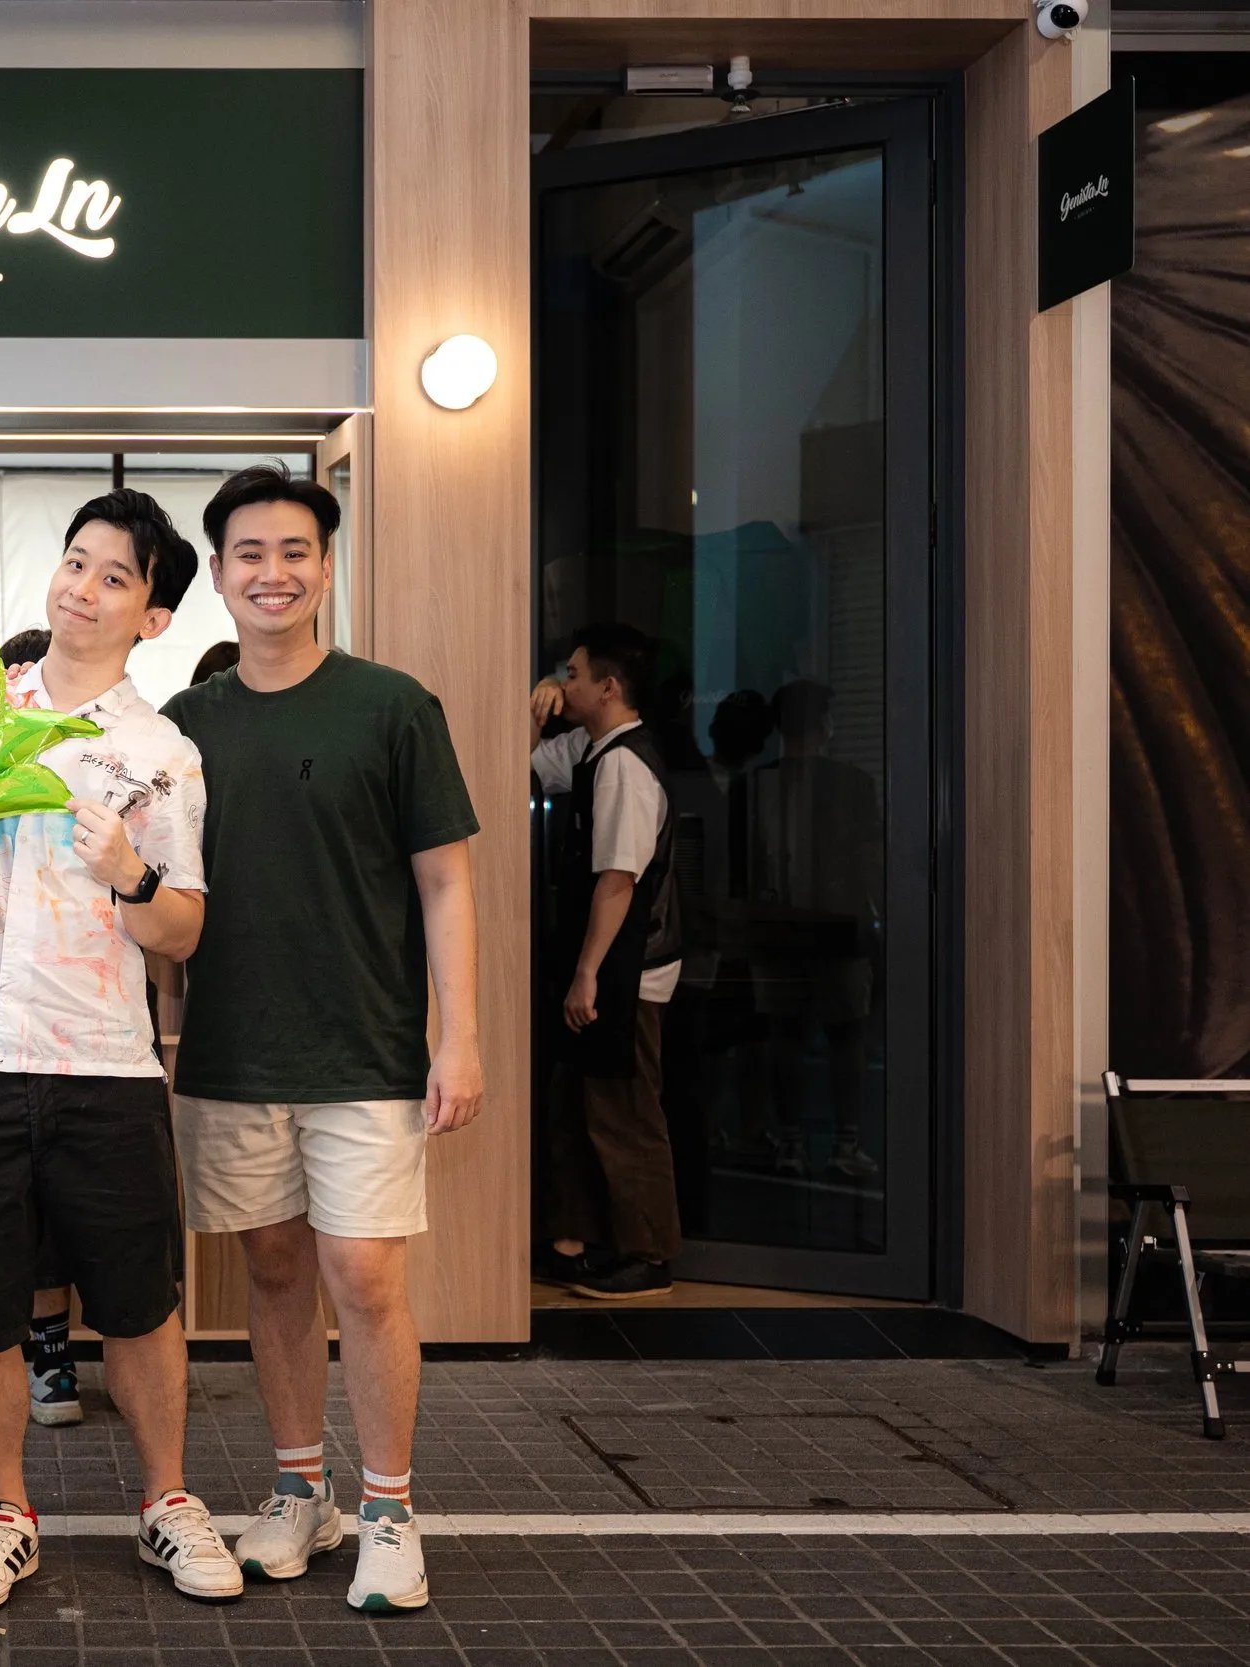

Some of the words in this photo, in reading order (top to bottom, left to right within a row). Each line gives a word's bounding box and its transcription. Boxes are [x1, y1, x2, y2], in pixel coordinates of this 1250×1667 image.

[7, 157, 121, 260] Ln
[1060, 181, 1097, 222] Genista
[1095, 174, 1110, 197] Ln
